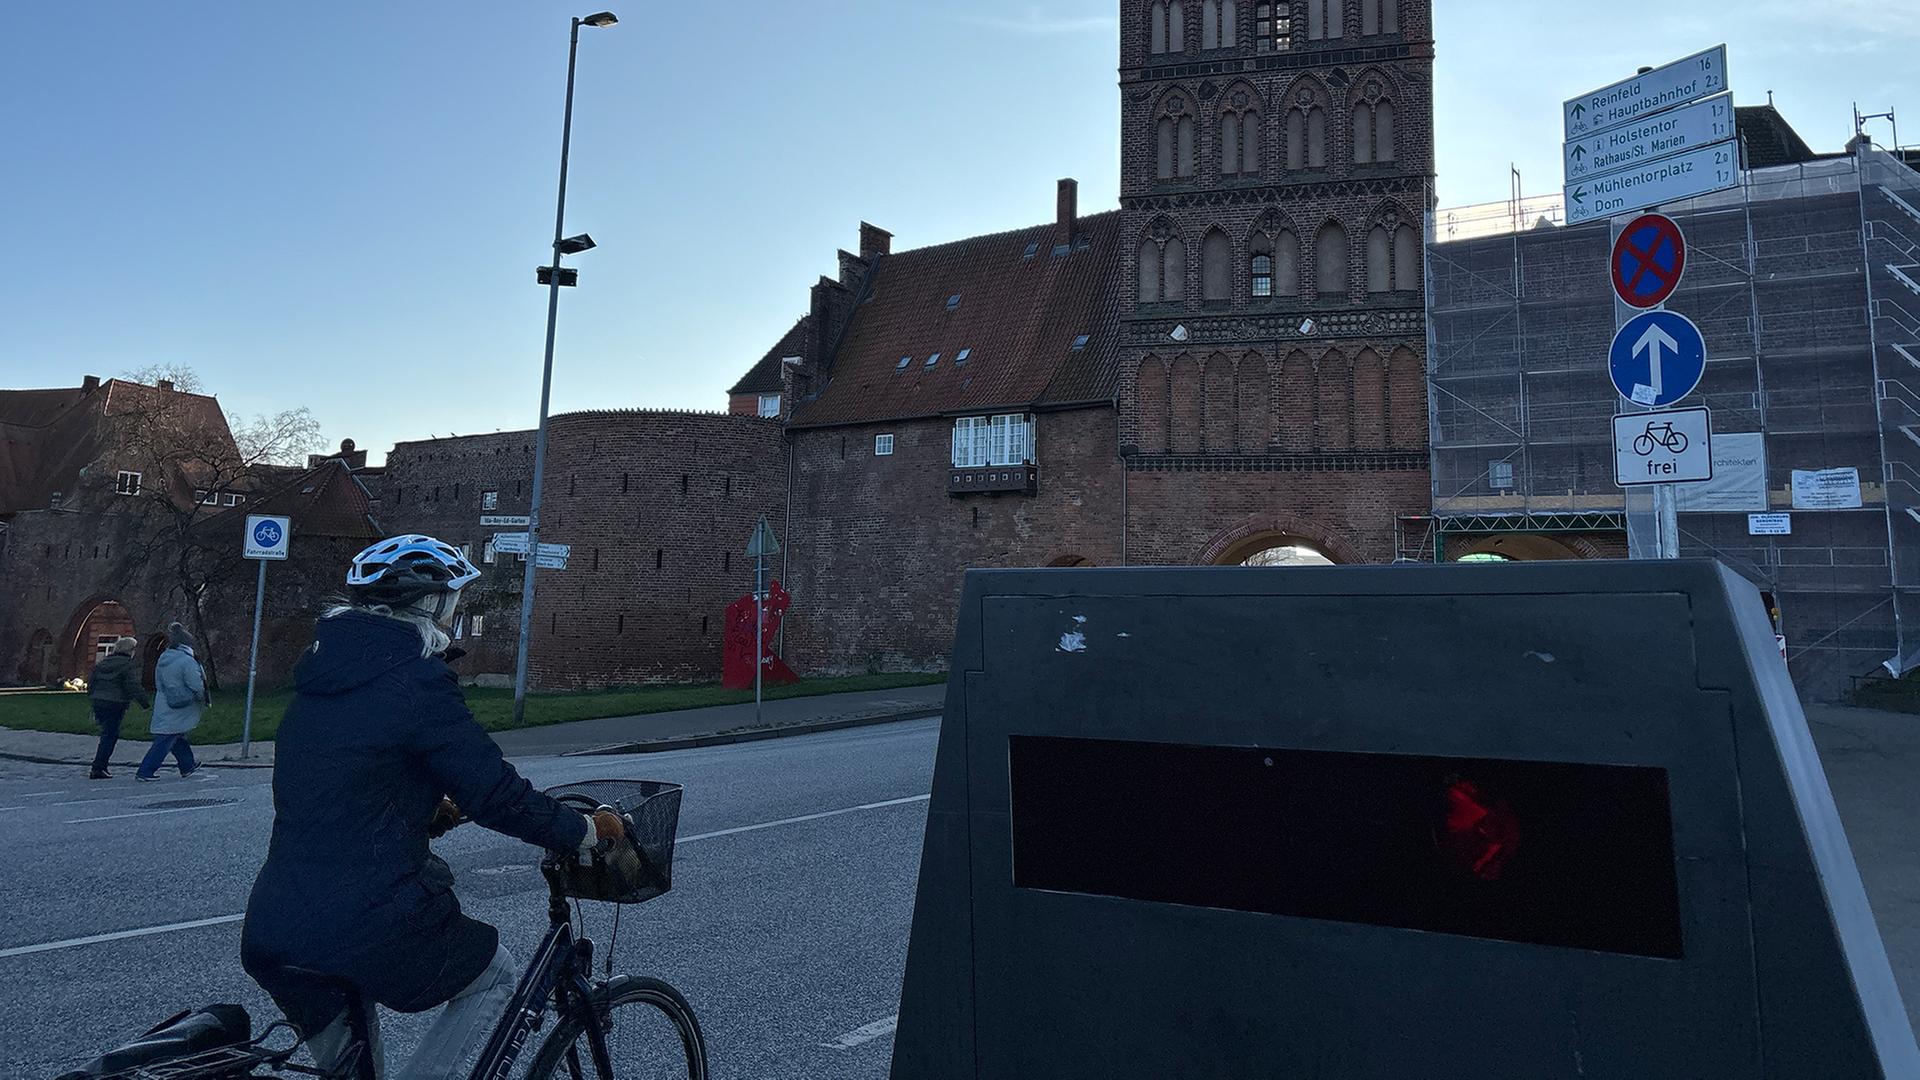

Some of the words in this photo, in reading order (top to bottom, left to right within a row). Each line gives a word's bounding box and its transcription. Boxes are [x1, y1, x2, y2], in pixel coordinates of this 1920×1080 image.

[1592, 83, 1641, 110] Reinfeld
[1700, 57, 1711, 72] 16
[1608, 80, 1697, 121] Hauptbahnhof
[1705, 75, 1719, 88] 2.2
[1593, 145, 1648, 169] Rathaus/St.
[1651, 135, 1685, 153] Marien
[1712, 122, 1725, 136] 1.1
[1609, 118, 1678, 147] Holstentor
[1711, 105, 1724, 118] 1.7
[1594, 161, 1693, 195] Mühlentorplatz
[1595, 197, 1624, 212] Dom
[1716, 169, 1729, 183] 1.7
[1647, 458, 1677, 475] frei
[1713, 457, 1757, 467] rchitekten
